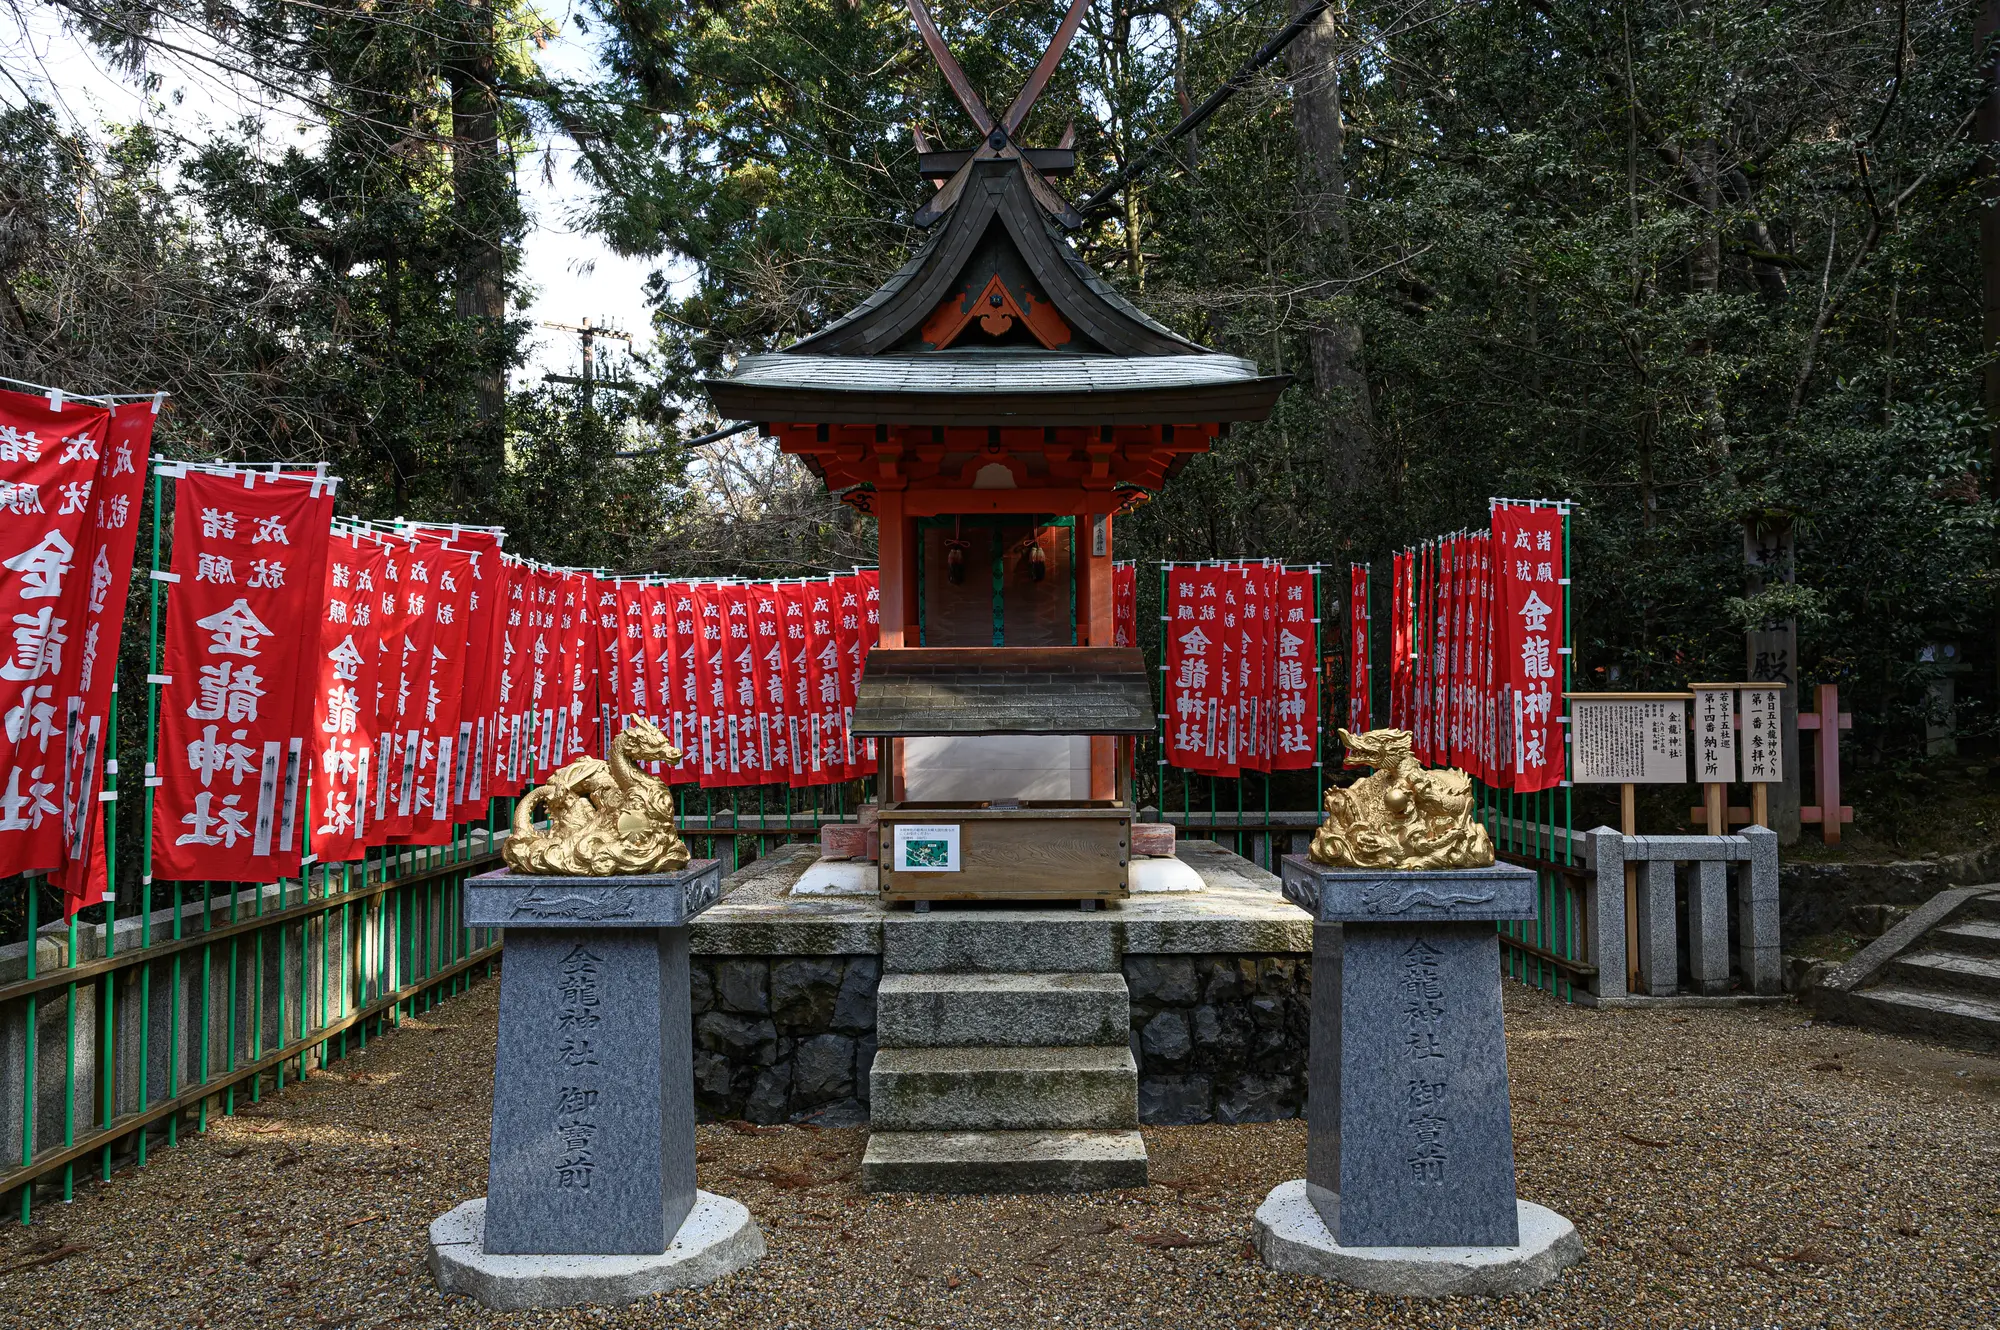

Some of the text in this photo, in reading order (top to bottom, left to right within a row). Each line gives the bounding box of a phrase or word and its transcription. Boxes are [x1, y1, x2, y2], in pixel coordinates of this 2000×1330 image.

[1514, 528, 1532, 583] 成就
[1535, 531, 1554, 583] 諸願
[600, 591, 618, 629] 成就
[627, 601, 643, 638] 成就
[652, 601, 668, 638] 成就
[676, 597, 694, 636] 成就
[703, 602, 721, 640] 成就
[730, 600, 748, 638] 成就
[757, 598, 776, 636] 成就
[786, 602, 805, 639] 成就
[812, 597, 831, 636] 成就
[842, 592, 858, 630] 成就
[1287, 586, 1305, 622] 諸願
[1279, 628, 1312, 753] 金龍神社
[1518, 590, 1556, 768] 金龍神社
[1719, 692, 1731, 748] 若宮十五社巡
[1751, 693, 1763, 730] 第一番
[1667, 711, 1680, 759] 金龍神社
[1703, 693, 1718, 776] 第十四番 納札所
[1766, 692, 1777, 777] 春日五大龍神めぐり
[554, 943, 604, 1190] 金龍神社 御寶前
[1401, 937, 1447, 1186] 金龍神社 御寶前
